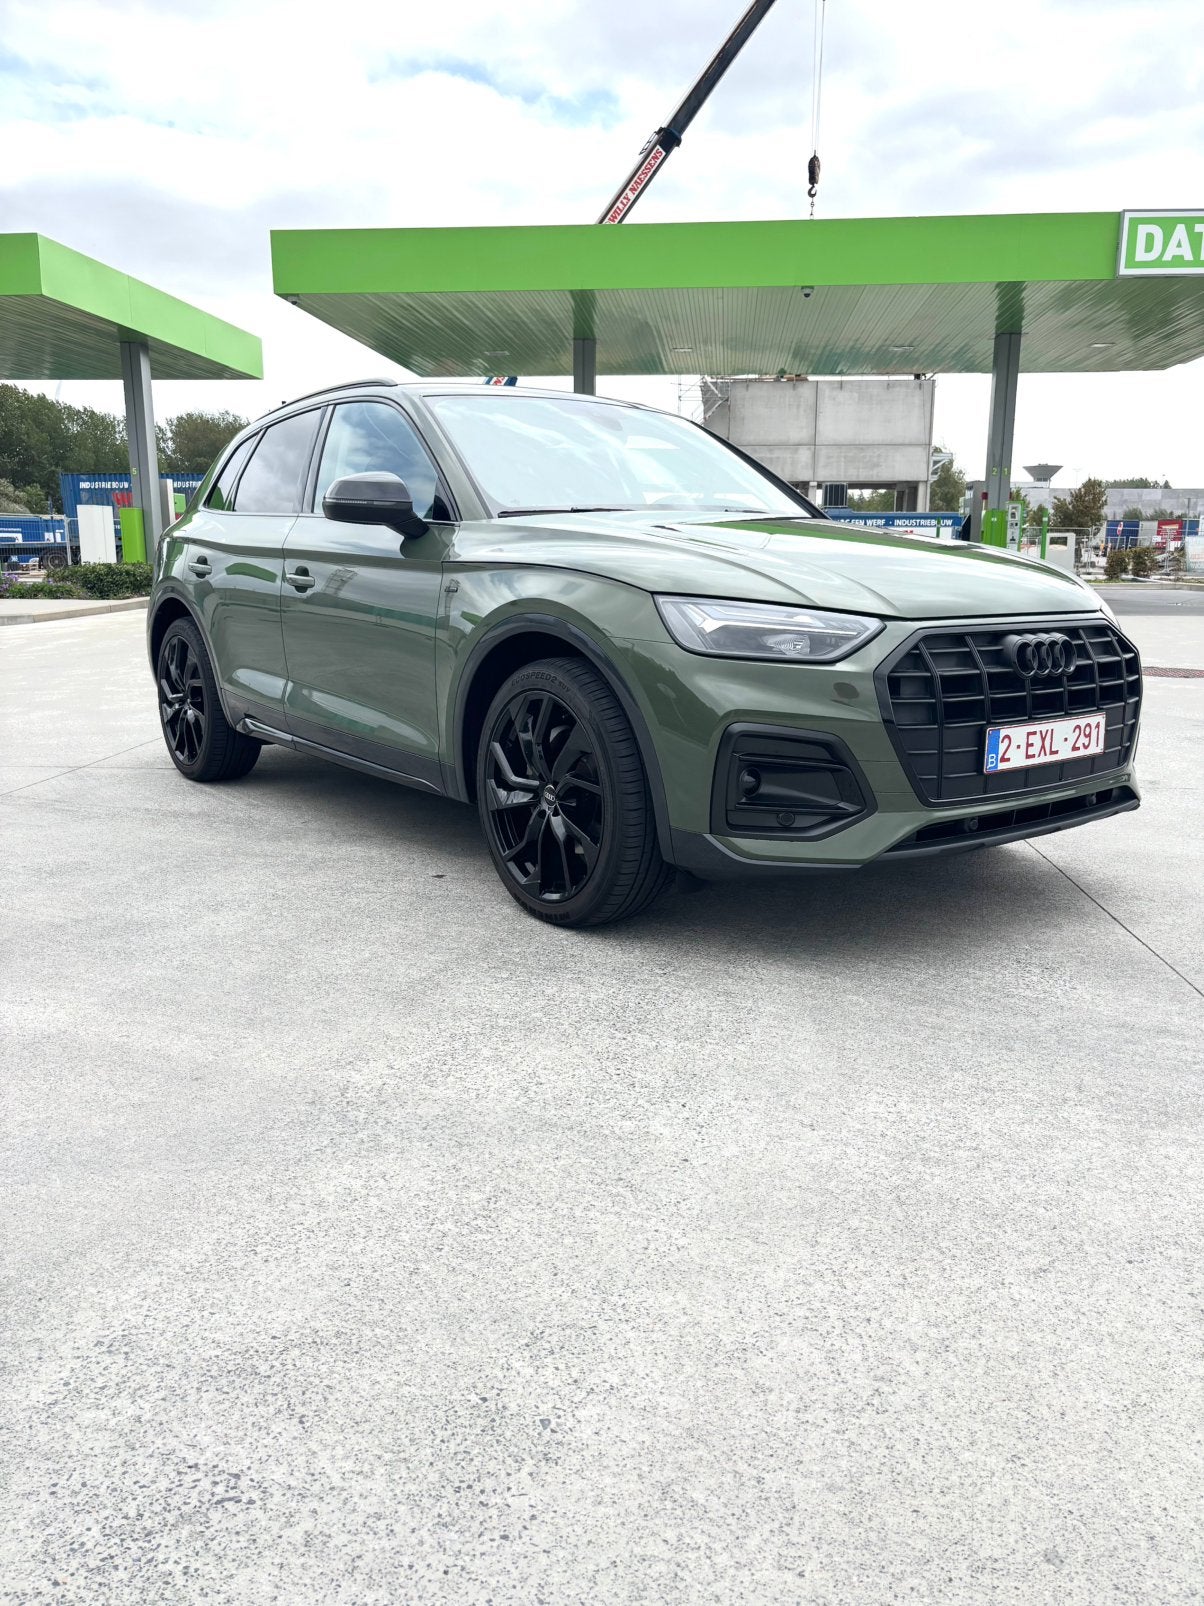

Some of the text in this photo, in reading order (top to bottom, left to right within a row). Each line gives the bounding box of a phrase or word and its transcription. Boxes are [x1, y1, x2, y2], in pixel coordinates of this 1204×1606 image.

[608, 148, 664, 223] WILLY NAESSENS
[132, 467, 137, 475] 5
[991, 467, 998, 475] 2
[1003, 467, 1008, 475] 1
[79, 481, 129, 489] INDUSTRIEBOUW
[987, 753, 997, 768] B
